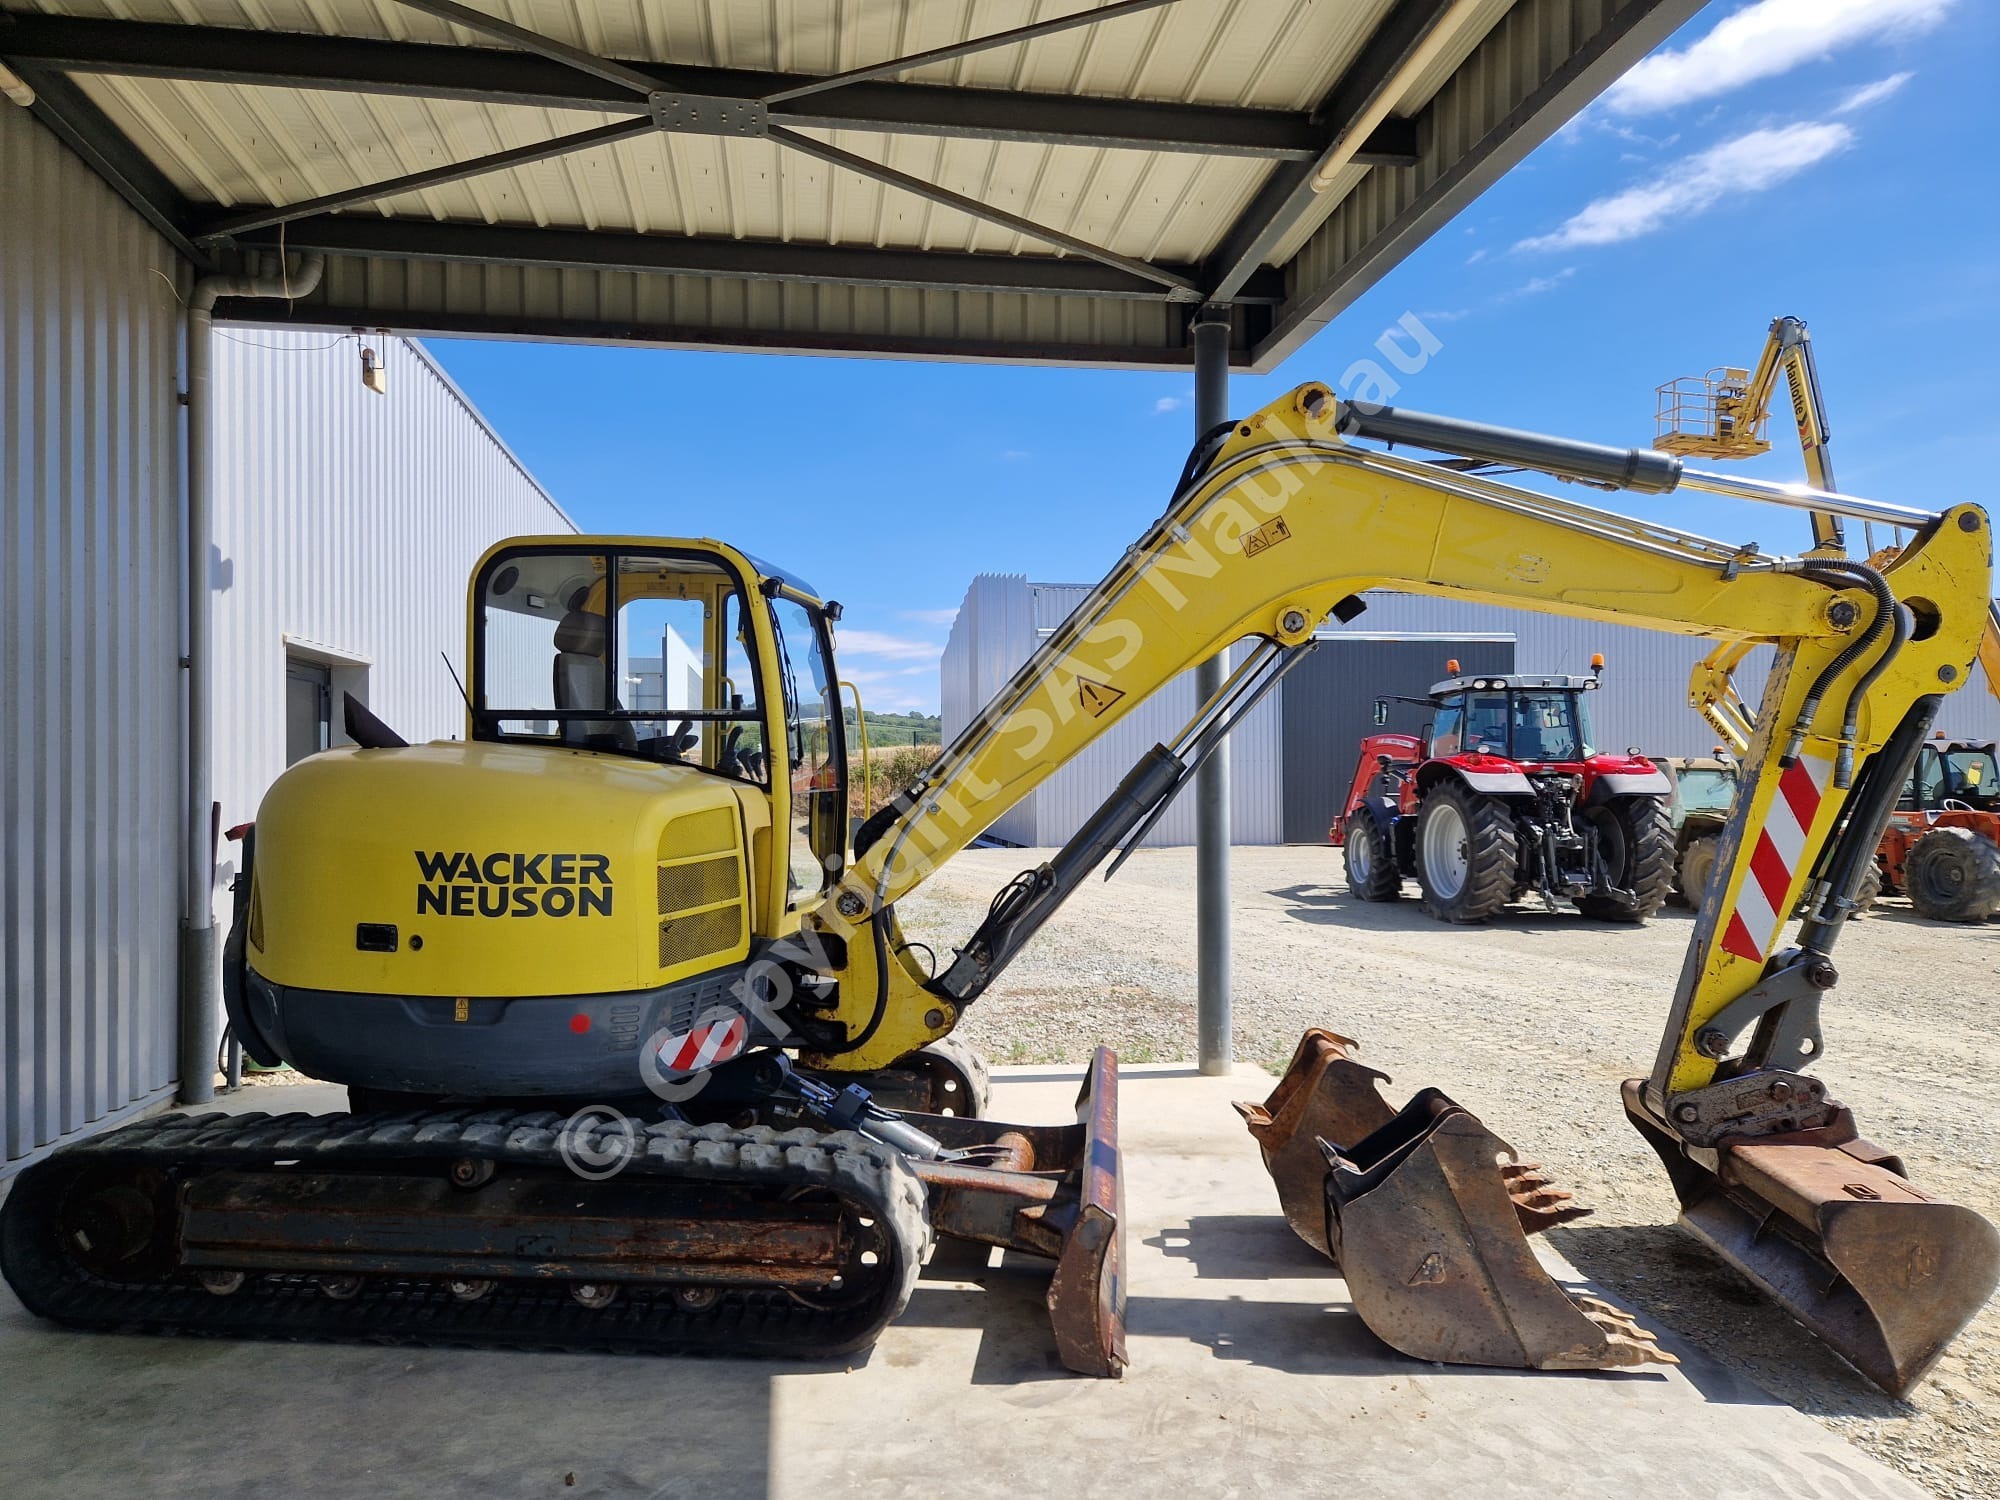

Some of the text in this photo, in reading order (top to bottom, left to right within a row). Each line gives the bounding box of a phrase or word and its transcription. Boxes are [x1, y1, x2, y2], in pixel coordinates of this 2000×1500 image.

[1785, 360, 1804, 416] Haulotte
[1703, 710, 1732, 744] HA16PX
[415, 850, 613, 885] WACKER
[416, 884, 613, 917] NEUSON
